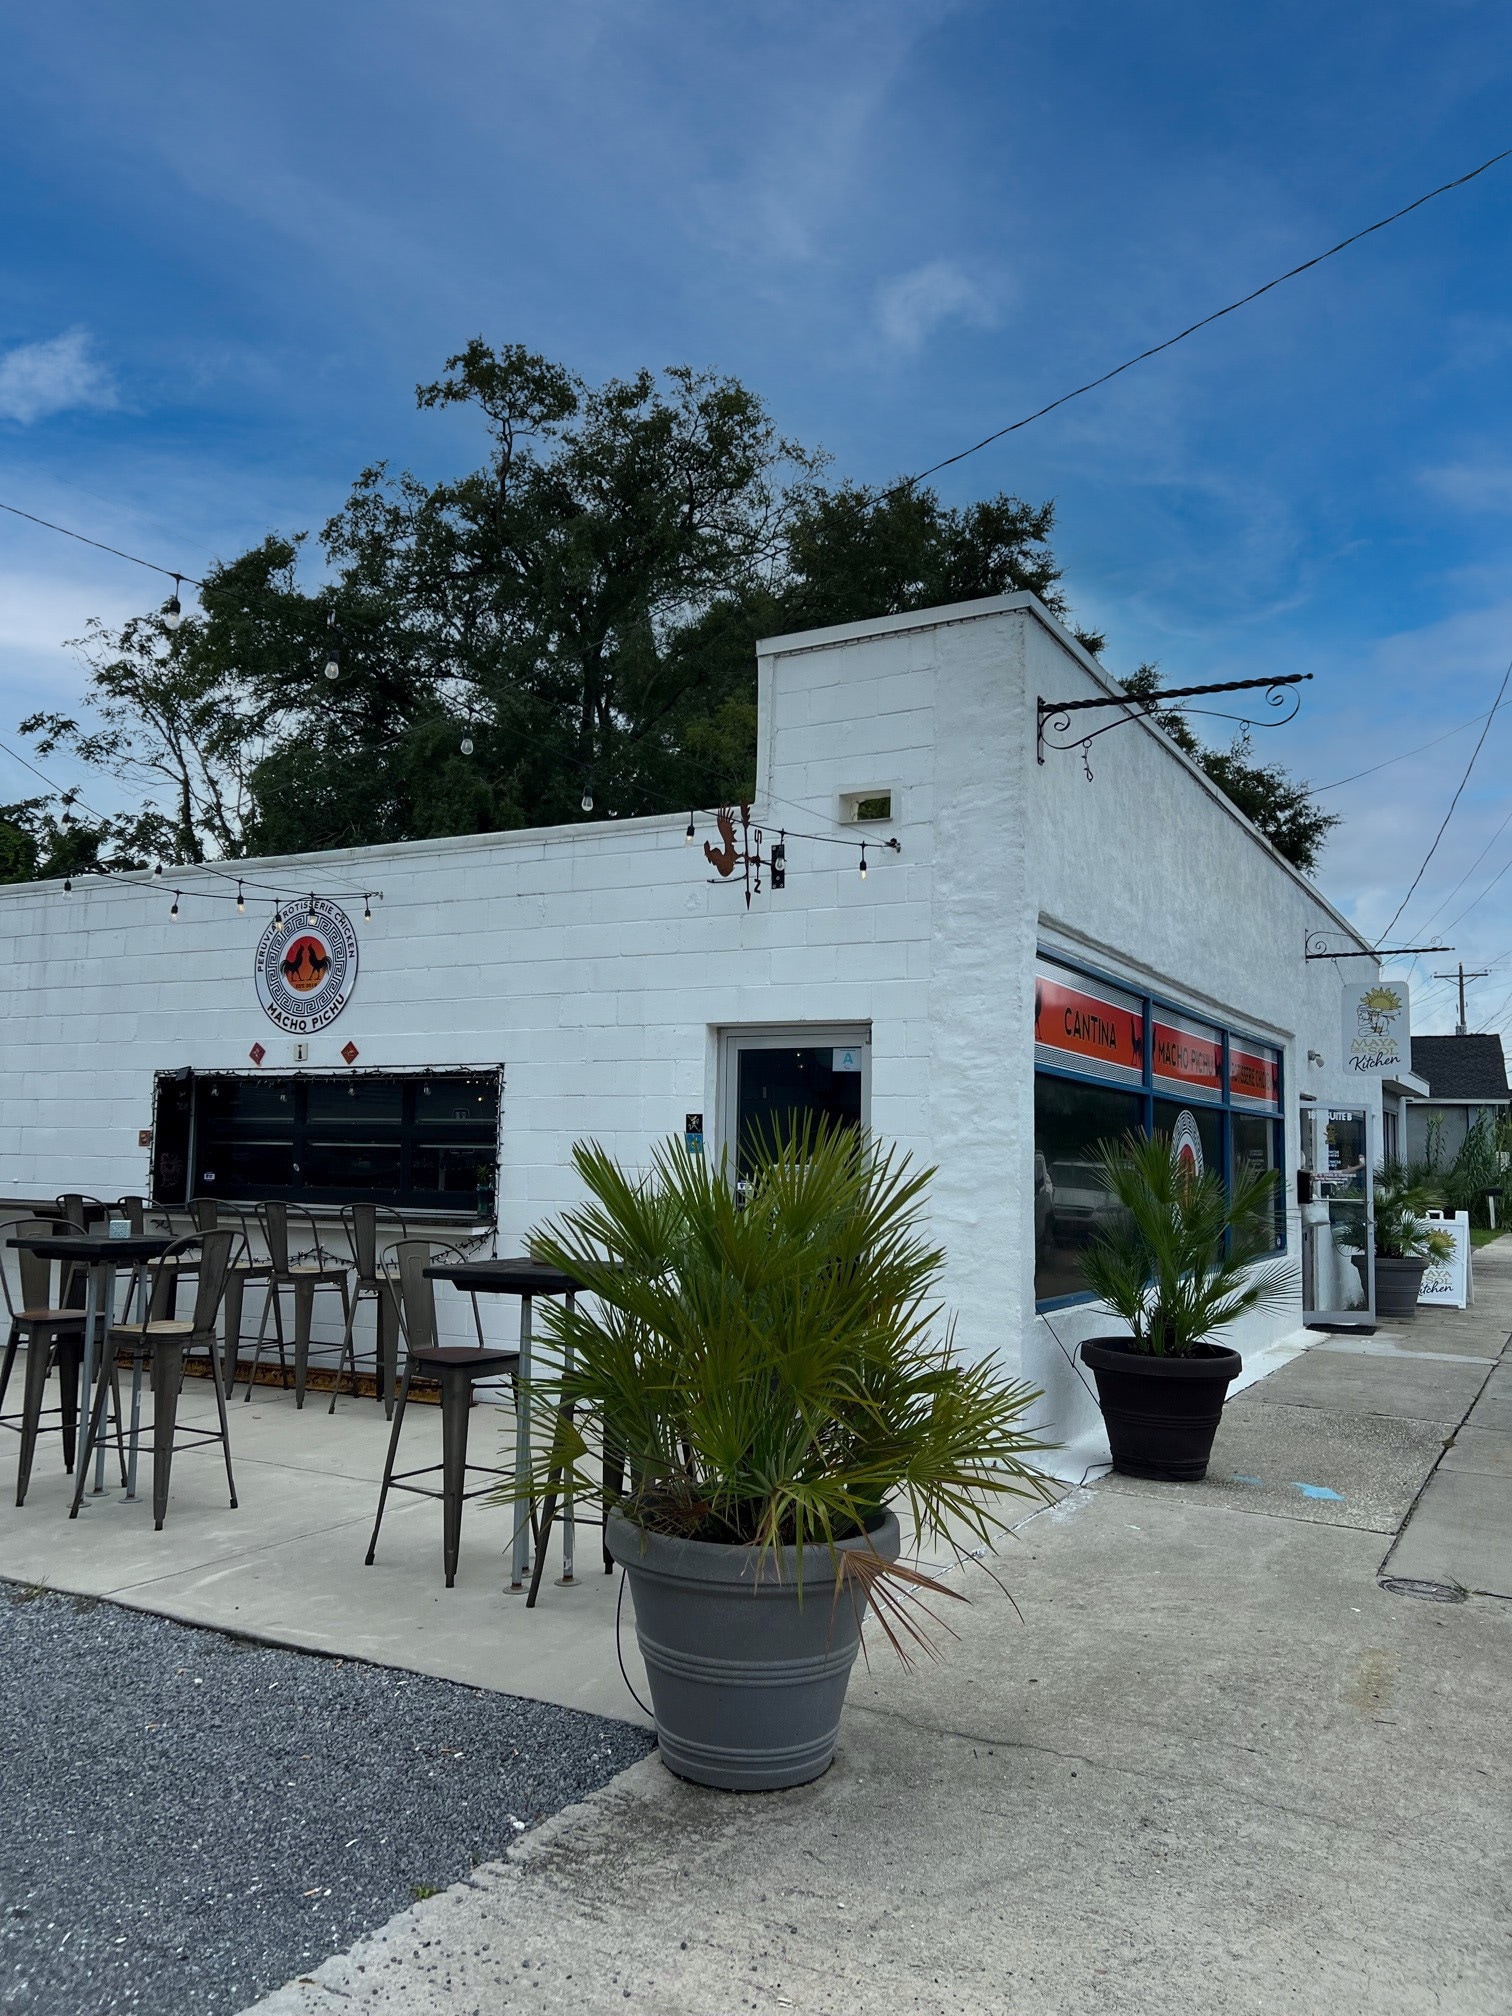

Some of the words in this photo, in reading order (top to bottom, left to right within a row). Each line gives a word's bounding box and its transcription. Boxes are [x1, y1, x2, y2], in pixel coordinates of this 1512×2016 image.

[257, 914, 284, 972] PERUVIA
[334, 911, 355, 958] CHICKEN
[267, 1002, 307, 1032] MACHO
[312, 993, 344, 1029] PICHU
[1064, 1007, 1117, 1050] CANTINA
[1350, 1038, 1399, 1047] MAYA
[1368, 1046, 1399, 1056] SOL
[843, 1052, 854, 1065] A
[1158, 1039, 1189, 1071] MACHO
[1191, 1049, 1215, 1077] PICHU
[1348, 1051, 1401, 1072] Kitchen
[1423, 1269, 1452, 1278] AYA
[1425, 1277, 1453, 1285] SOL
